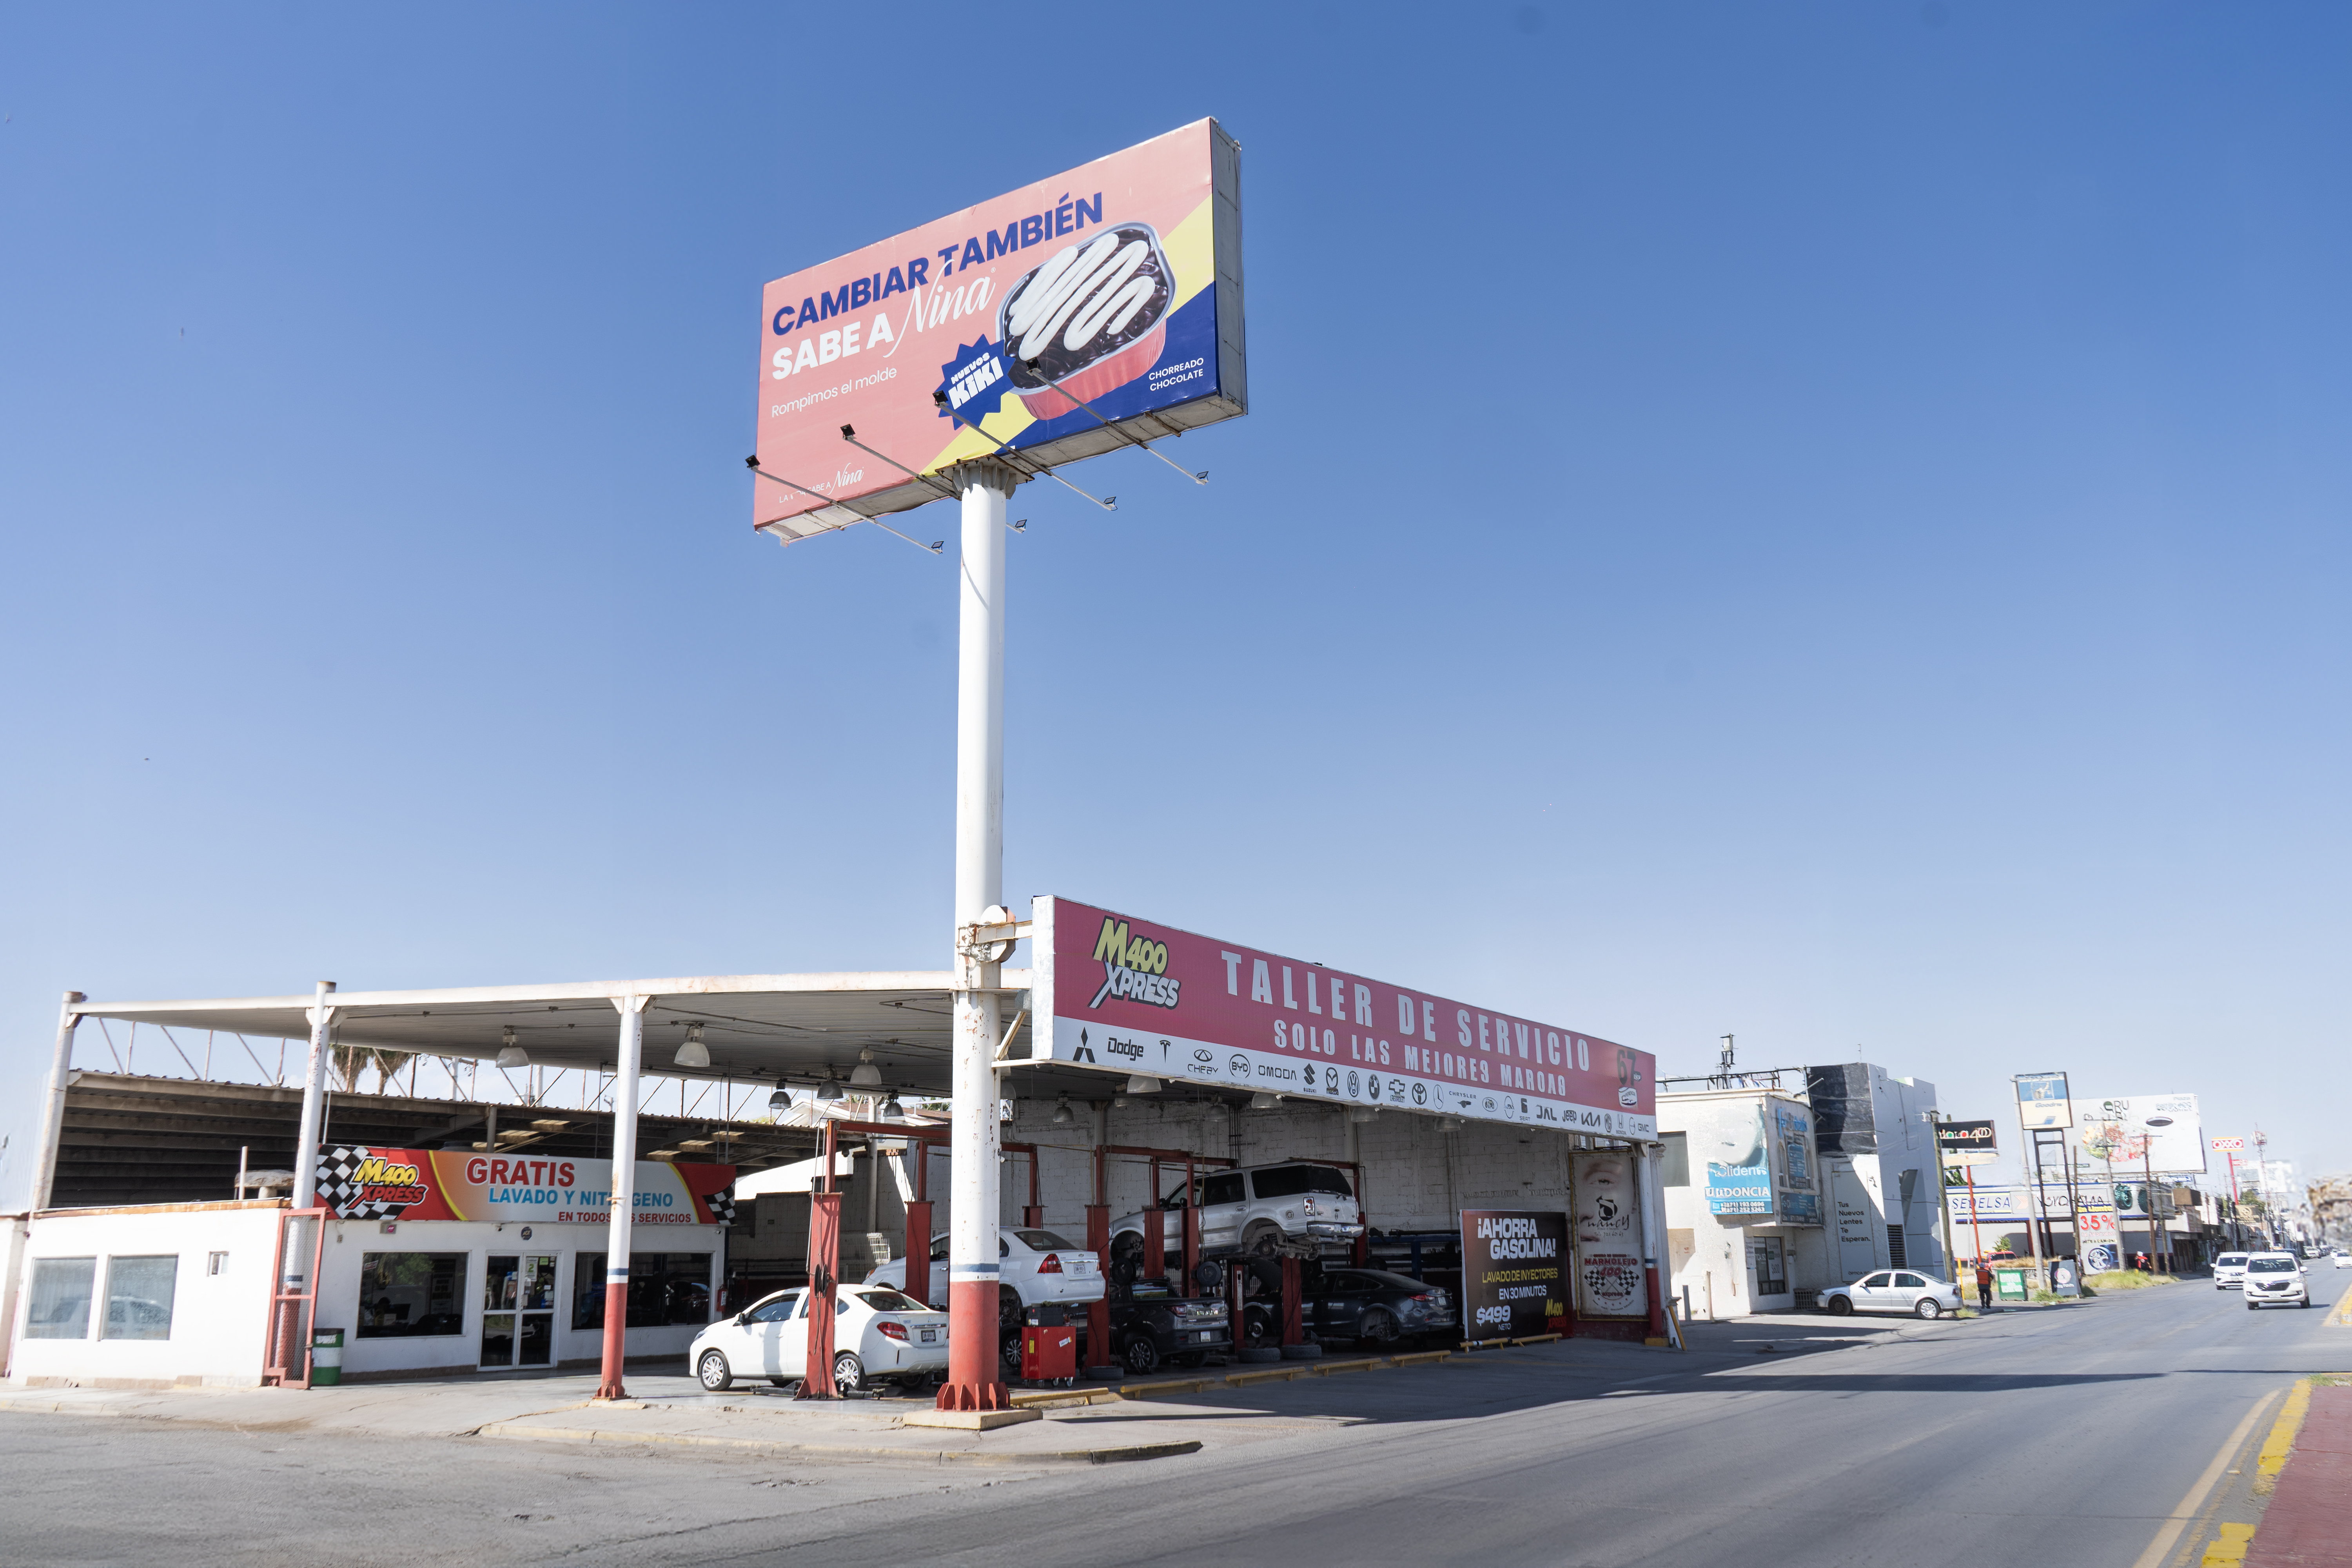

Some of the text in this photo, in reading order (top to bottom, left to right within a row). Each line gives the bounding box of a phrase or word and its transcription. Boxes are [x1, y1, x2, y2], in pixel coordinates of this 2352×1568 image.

[773, 191, 1102, 336] CAMBIAR TAMBIÉN
[772, 259, 996, 380] SABE A Nina
[951, 352, 990, 385] NUEVOS
[1149, 358, 1204, 380] CHORREADO
[1150, 368, 1203, 391] CHOCOLATE
[771, 367, 897, 417] Rompimos el molde
[779, 494, 788, 503] LA
[807, 483, 825, 492] SABE
[827, 463, 864, 495] Nina
[1093, 915, 1169, 976] M400
[1087, 960, 1181, 1009] XPRESS
[1221, 950, 1590, 1072] TALLER DE SERVICIO
[1107, 1036, 1144, 1062] Dodge
[1274, 1019, 1335, 1055] SOLO
[1351, 1034, 1390, 1065] LAS
[1404, 1045, 1489, 1083] MEJORES
[1232, 1061, 1248, 1073] BYD
[1258, 1065, 1297, 1081] OMODA
[1617, 1049, 1636, 1087] 67
[1449, 1091, 1477, 1099] CHRYSLER
[1562, 1110, 1577, 1123] Jeep
[1638, 1123, 1650, 1132] GMC
[2213, 1140, 2243, 1149] OXXO
[352, 1158, 418, 1186] M400
[466, 1157, 575, 1187] GRATIS
[345, 1185, 427, 1210] XPRESS
[488, 1187, 673, 1207] LAVADO Y NITGENO
[558, 1212, 573, 1222] EN
[577, 1212, 612, 1223] TODOS
[639, 1213, 691, 1223] SERVICIOS
[1477, 1218, 1538, 1238] ¡AHORRA
[2080, 1214, 2116, 1231] 35%
[1490, 1238, 1556, 1259] GASOLINA!
[1482, 1268, 1558, 1283] LAVADO DE INYECTORES
[1599, 1267, 1623, 1278] 400
[1499, 1285, 1547, 1300] EN 30 MINUTOS
[1476, 1305, 1511, 1327] $499
[1545, 1299, 1563, 1317] M400
[1546, 1316, 1567, 1335] XPRESS
